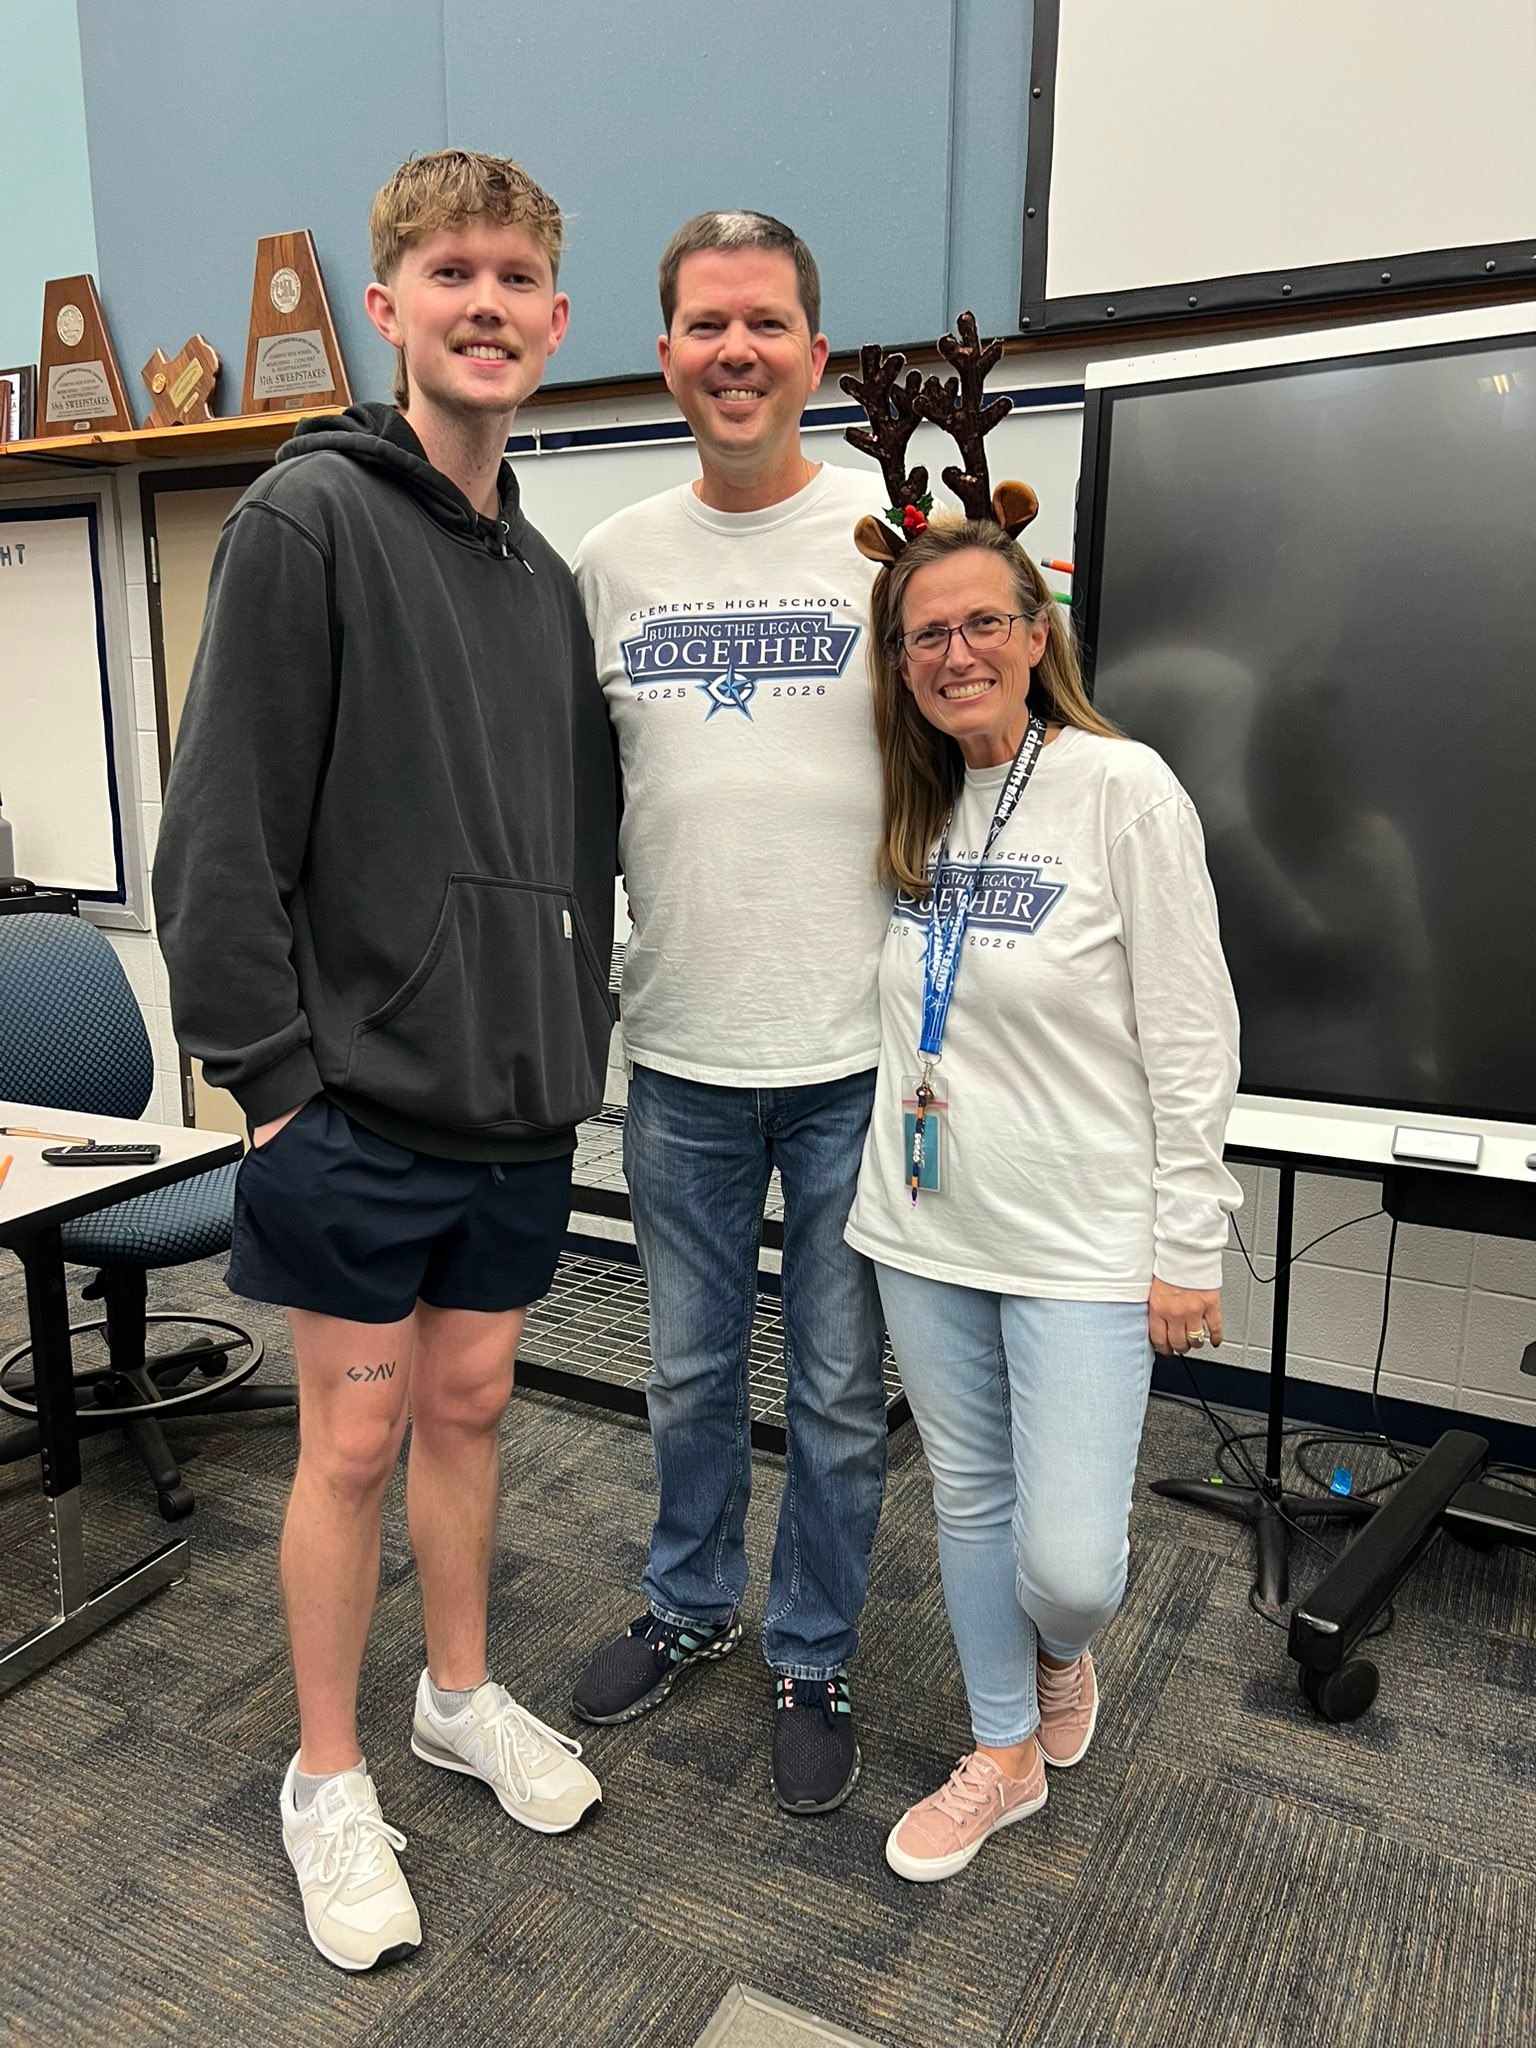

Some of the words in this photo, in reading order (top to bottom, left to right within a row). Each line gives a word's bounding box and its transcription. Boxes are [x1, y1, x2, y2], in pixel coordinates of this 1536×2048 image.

[275, 368, 327, 384] SWEEPSTAKES
[65, 397, 109, 410] SWEEPSTAKES
[630, 601, 715, 622] CLEMENTS
[725, 599, 769, 609] HIGH
[779, 598, 852, 608] SCHOOL
[650, 624, 722, 641] BUILDING
[725, 621, 754, 637] THE
[760, 621, 822, 636] LEGACY
[635, 636, 835, 670] TOGETHER
[637, 688, 686, 701] 2025
[772, 685, 826, 697] 2026
[1010, 729, 1039, 787] CLEMENTS
[996, 852, 1063, 865] SCHOOL
[898, 886, 1034, 919] GETHER
[970, 936, 1016, 949] 2026
